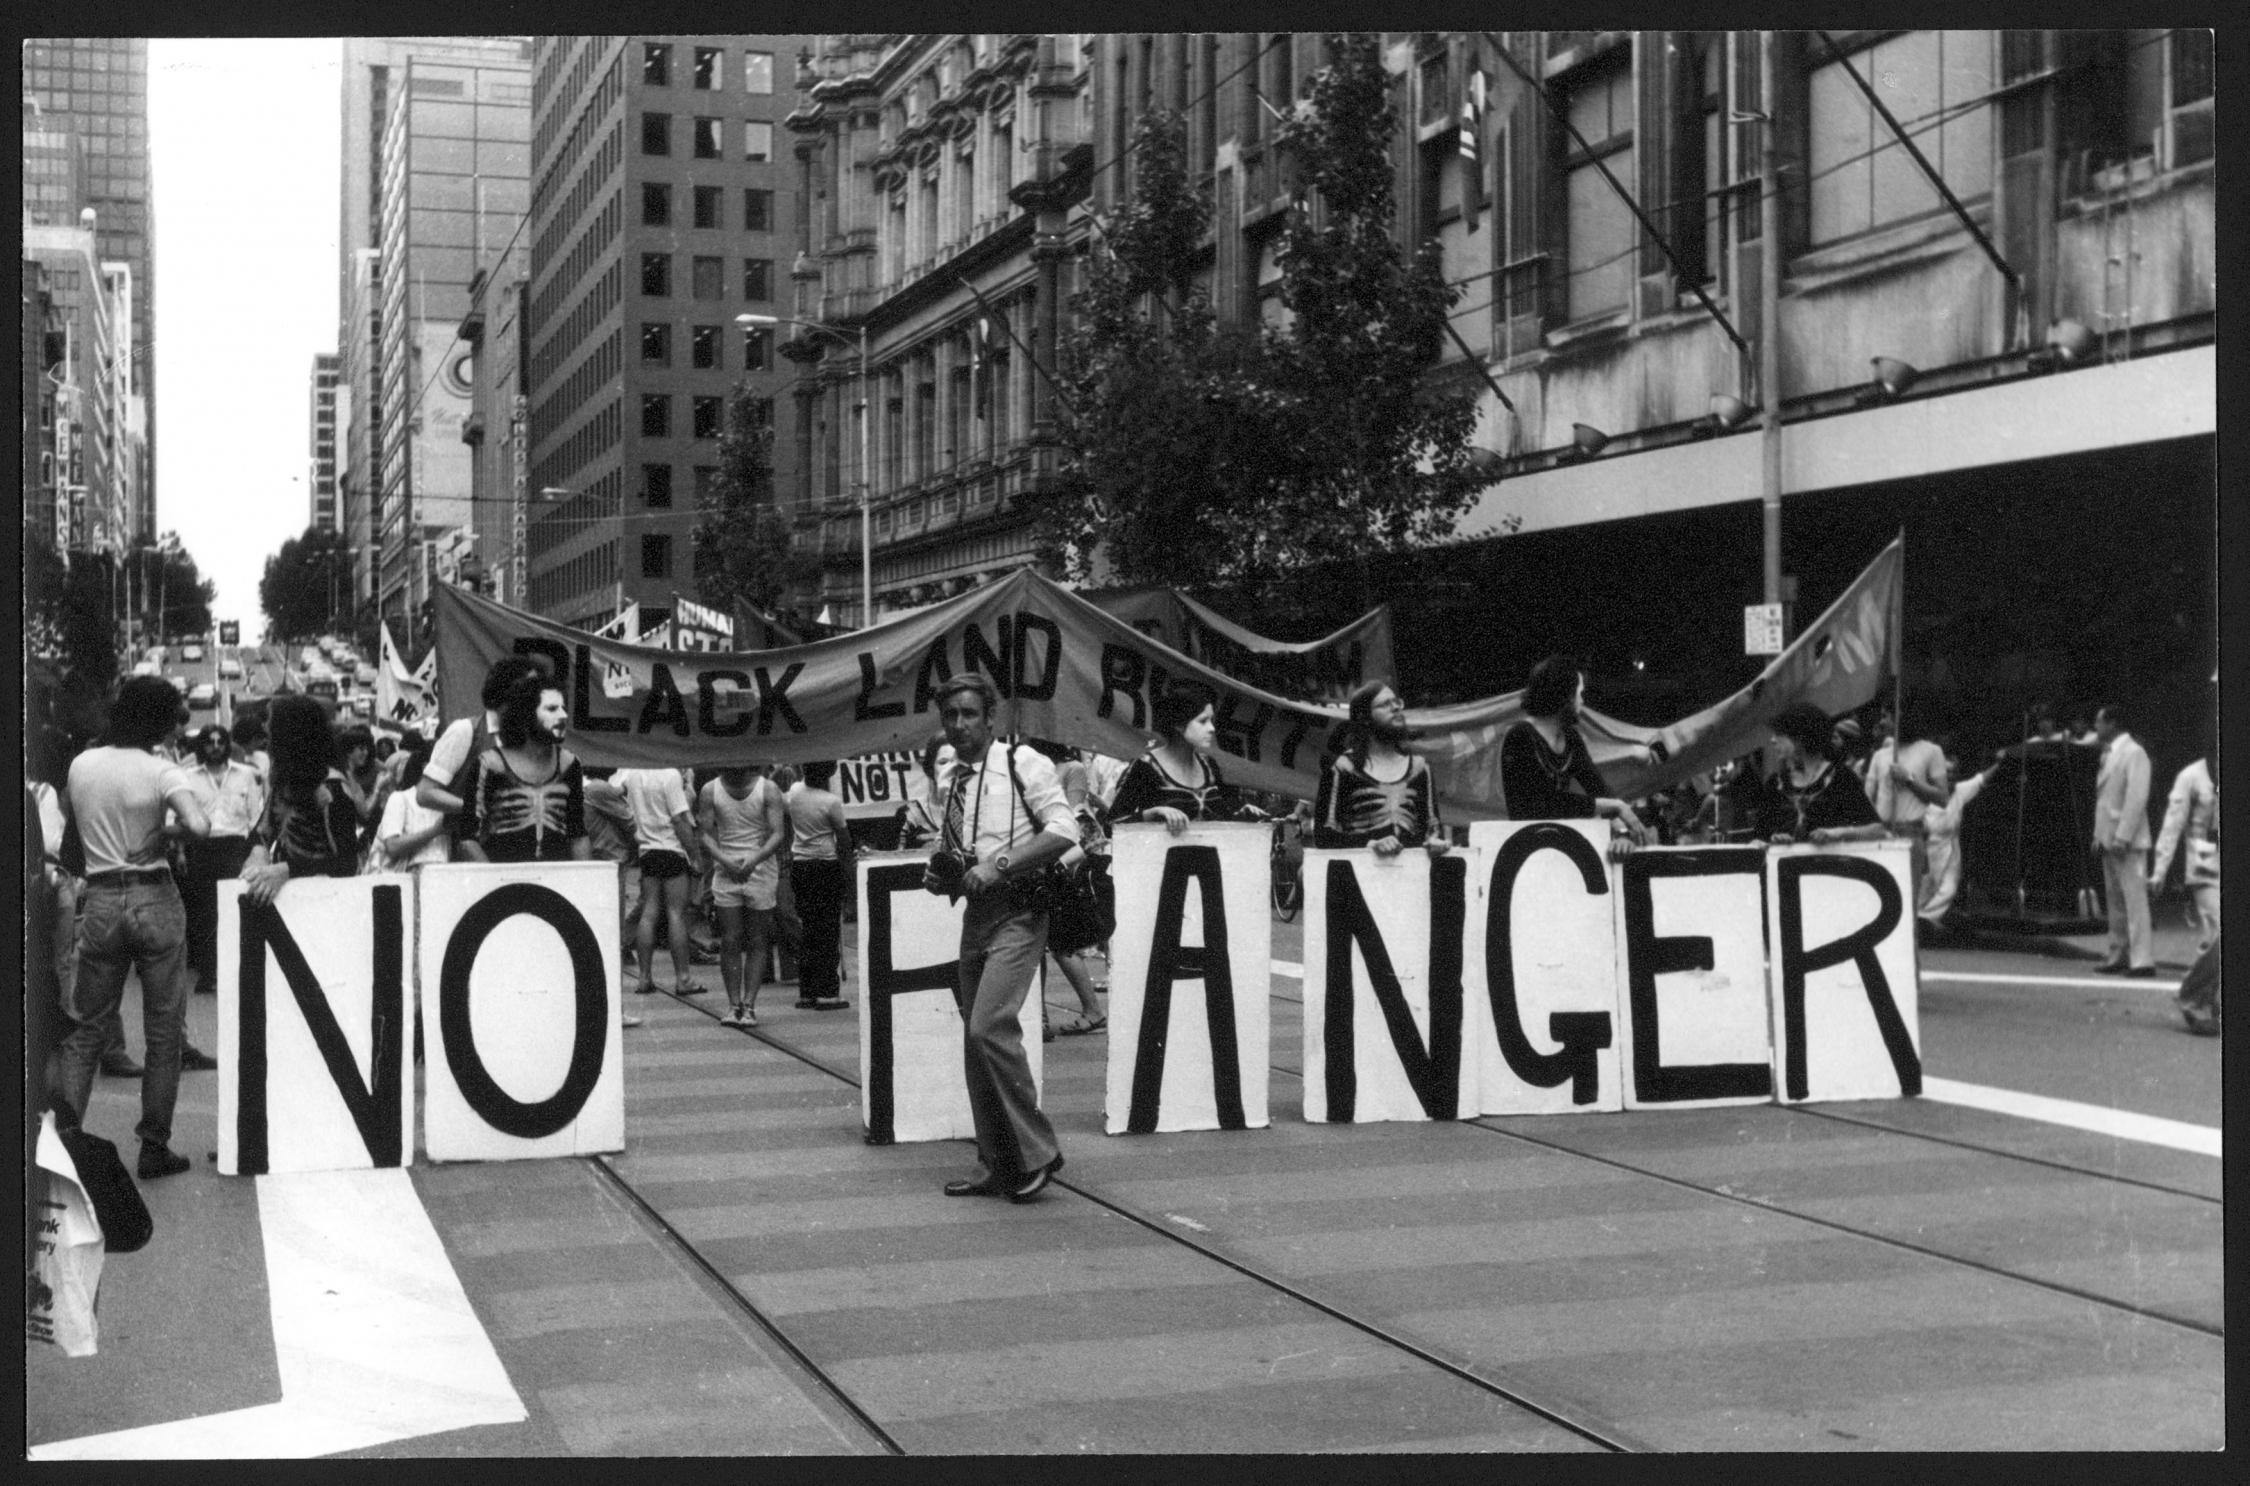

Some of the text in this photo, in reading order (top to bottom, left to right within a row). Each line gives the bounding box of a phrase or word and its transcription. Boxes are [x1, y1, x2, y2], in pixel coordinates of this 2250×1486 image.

[855, 611, 1062, 720] LAND
[840, 761, 912, 804] NOT
[238, 882, 609, 1176] NO
